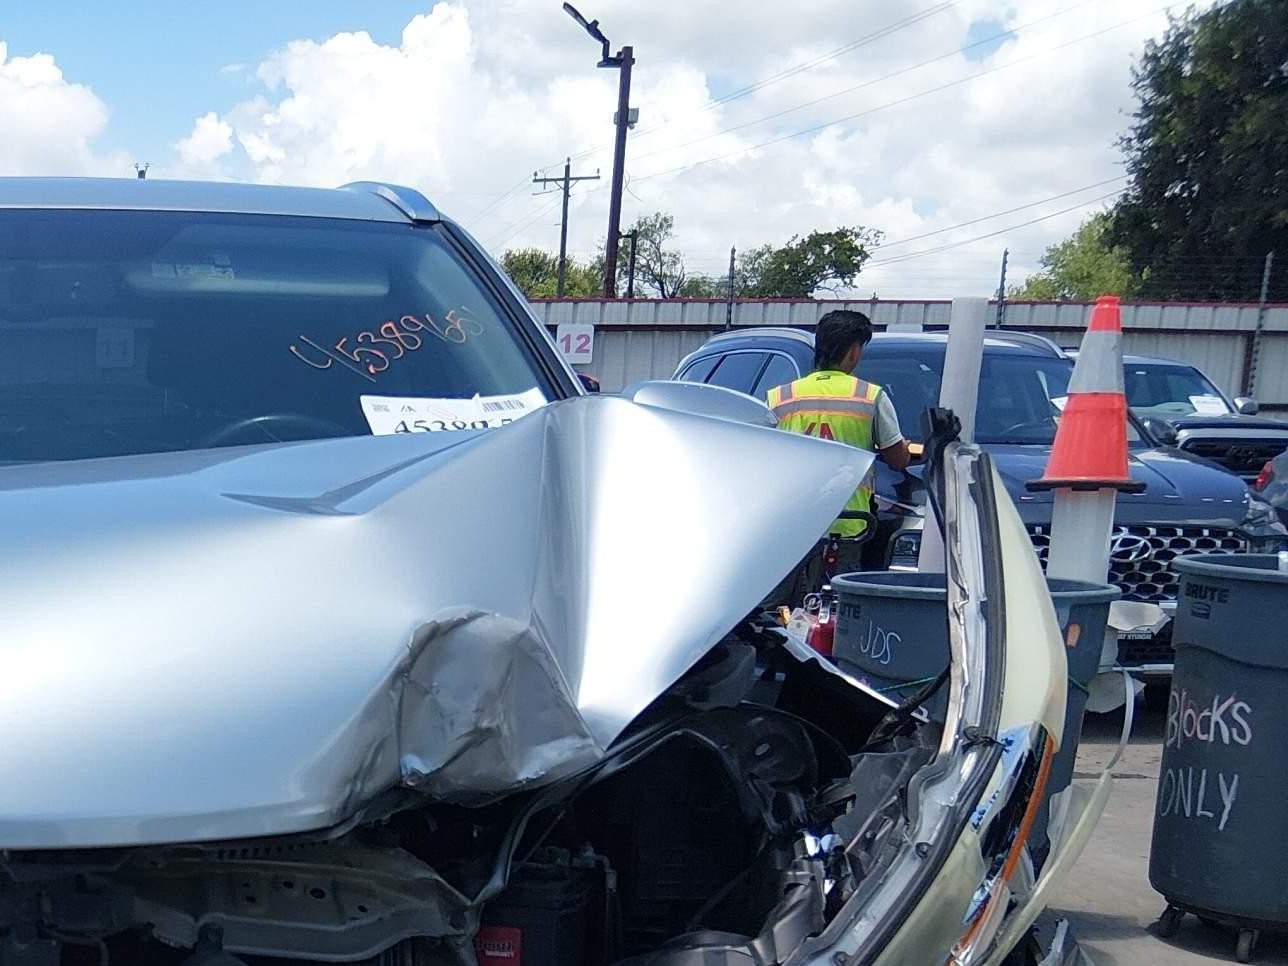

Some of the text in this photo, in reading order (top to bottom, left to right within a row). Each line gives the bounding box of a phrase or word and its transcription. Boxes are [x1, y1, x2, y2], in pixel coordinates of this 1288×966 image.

[560, 333, 591, 354] 12
[1185, 581, 1229, 604] BRUTE
[839, 602, 861, 619] UTE
[1161, 767, 1239, 831] ONLY
